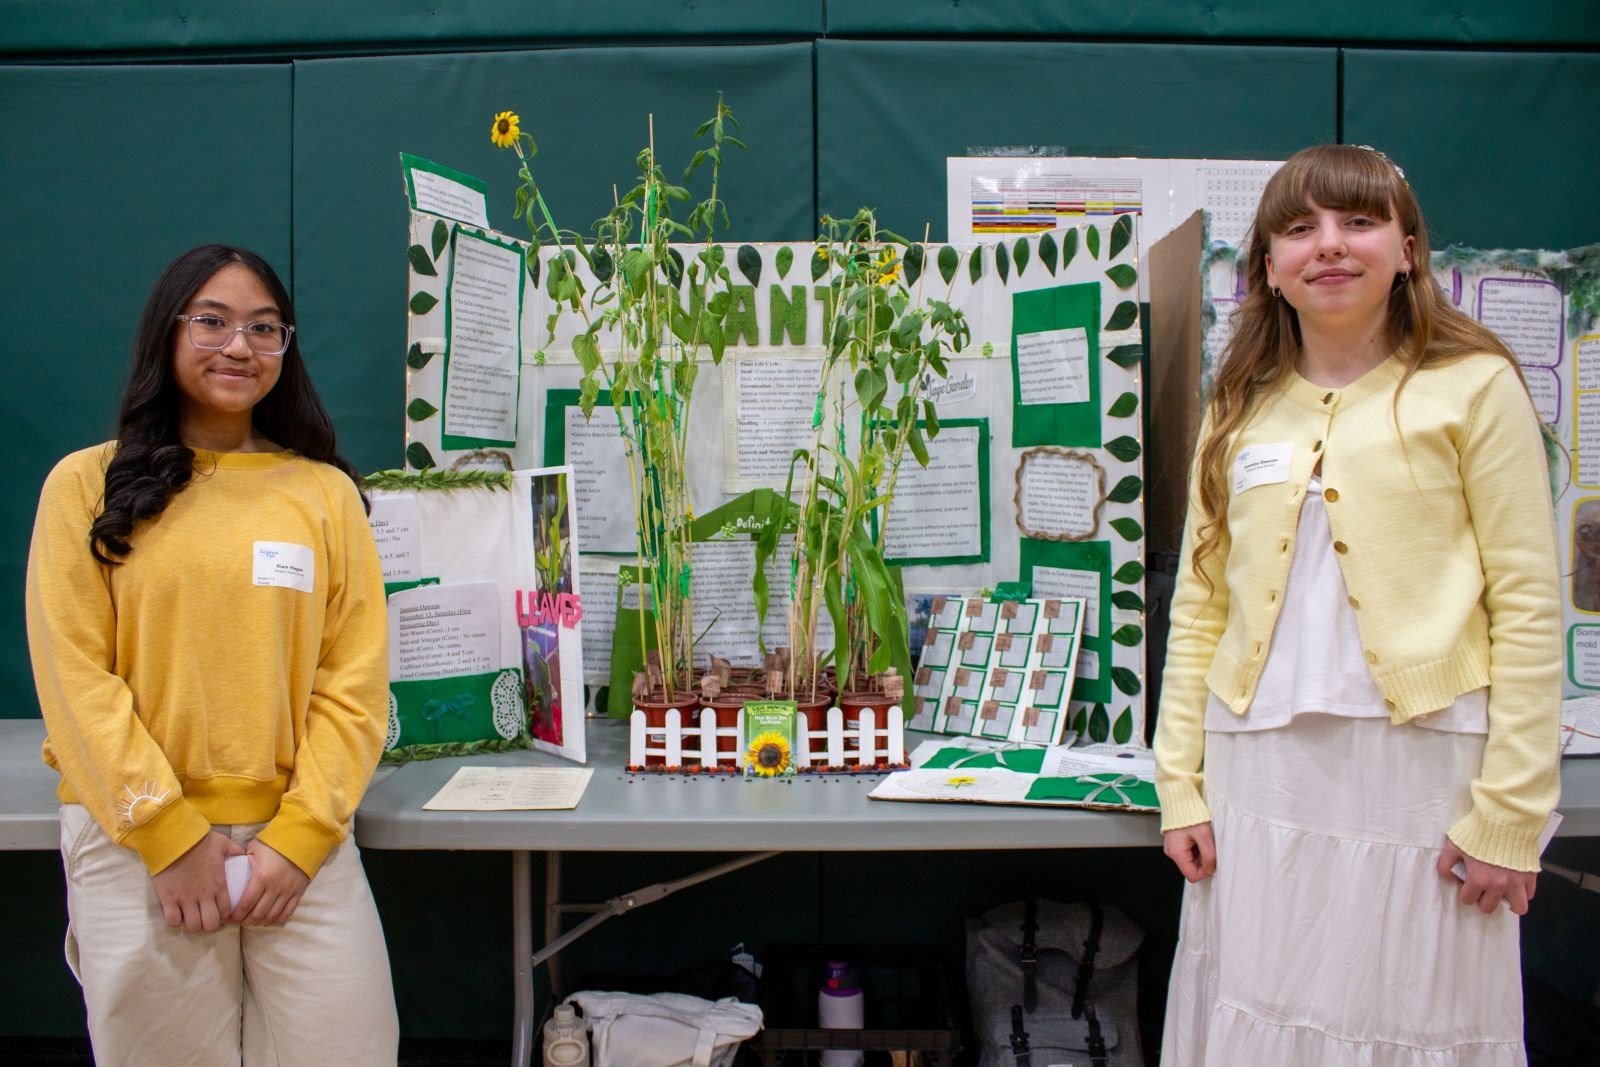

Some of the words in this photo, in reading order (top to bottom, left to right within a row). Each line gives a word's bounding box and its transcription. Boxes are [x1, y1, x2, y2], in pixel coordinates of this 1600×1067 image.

[516, 590, 583, 629] LEAVES
[400, 622, 425, 630] Measuring
[423, 660, 453, 669] (Sunflower)
[442, 666, 472, 675] (Sunflower)
